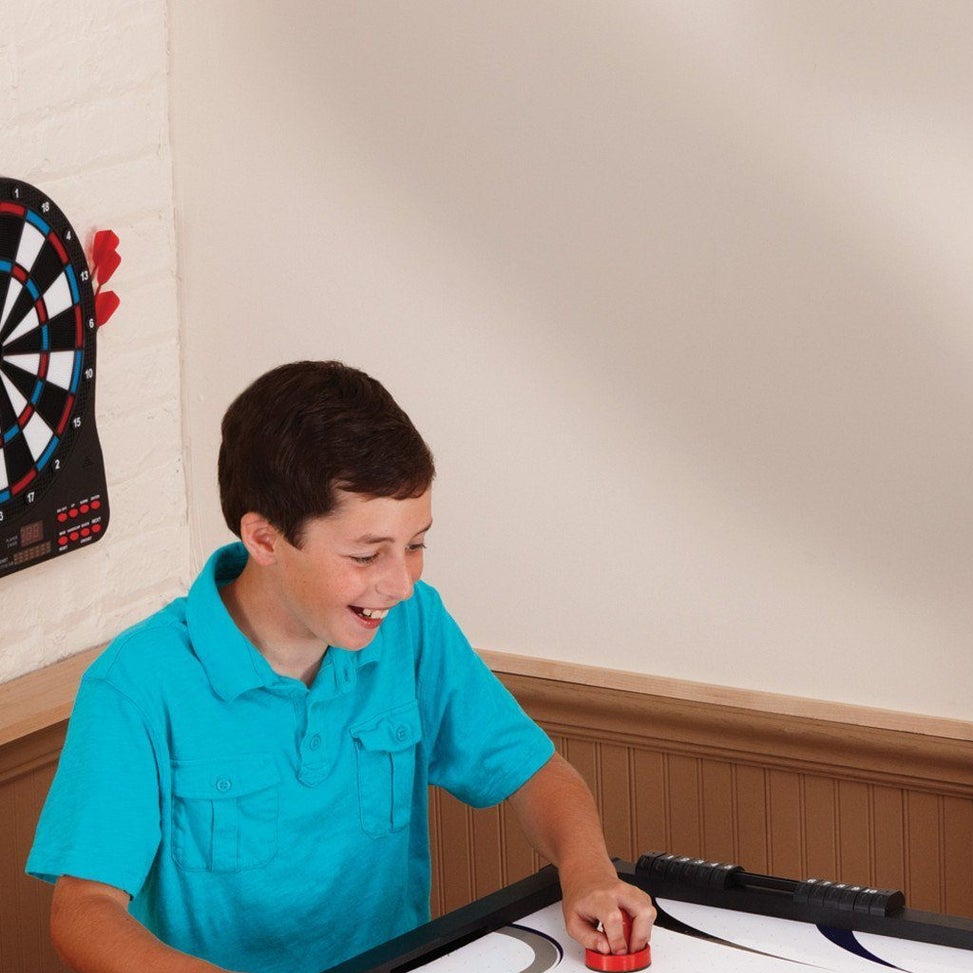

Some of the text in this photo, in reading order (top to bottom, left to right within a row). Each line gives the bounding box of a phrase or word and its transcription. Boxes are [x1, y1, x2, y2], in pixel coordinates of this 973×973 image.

[14, 188, 19, 199] 1
[41, 201, 50, 213] 18
[65, 230, 72, 241] 4
[80, 270, 89, 281] 13
[88, 318, 95, 328] 6
[85, 368, 94, 379] 10
[73, 416, 82, 428] 15
[54, 459, 61, 470] 2
[27, 491, 35, 503] 17
